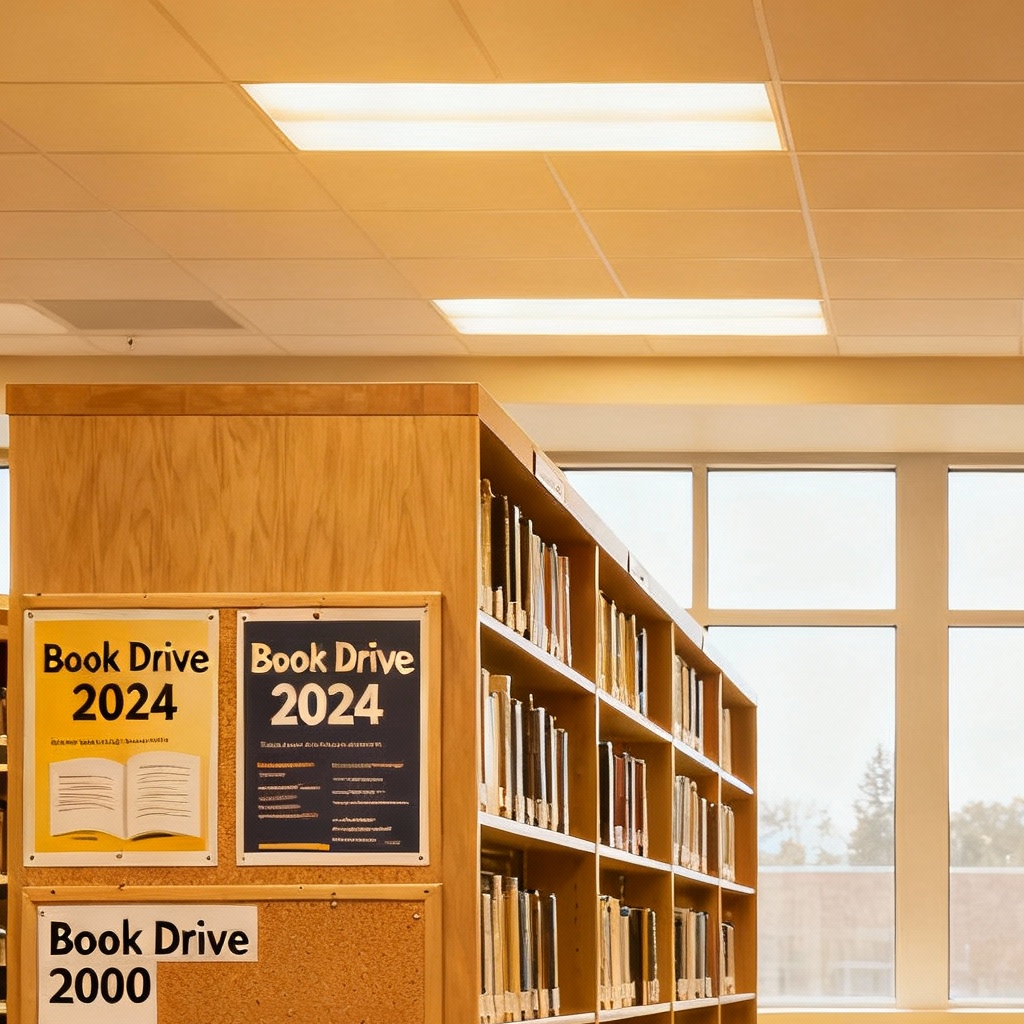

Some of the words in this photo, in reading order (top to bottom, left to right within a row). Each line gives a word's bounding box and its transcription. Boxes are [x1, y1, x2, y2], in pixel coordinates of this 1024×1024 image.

[43, 640, 121, 674] Book
[129, 640, 210, 674] Drive
[250, 640, 328, 675] Book
[334, 640, 416, 676] Drive
[72, 682, 178, 722] 2024
[270, 682, 385, 727] 2024
[50, 918, 143, 956] Book
[154, 918, 249, 956] Drive
[49, 966, 151, 1005] 2000
